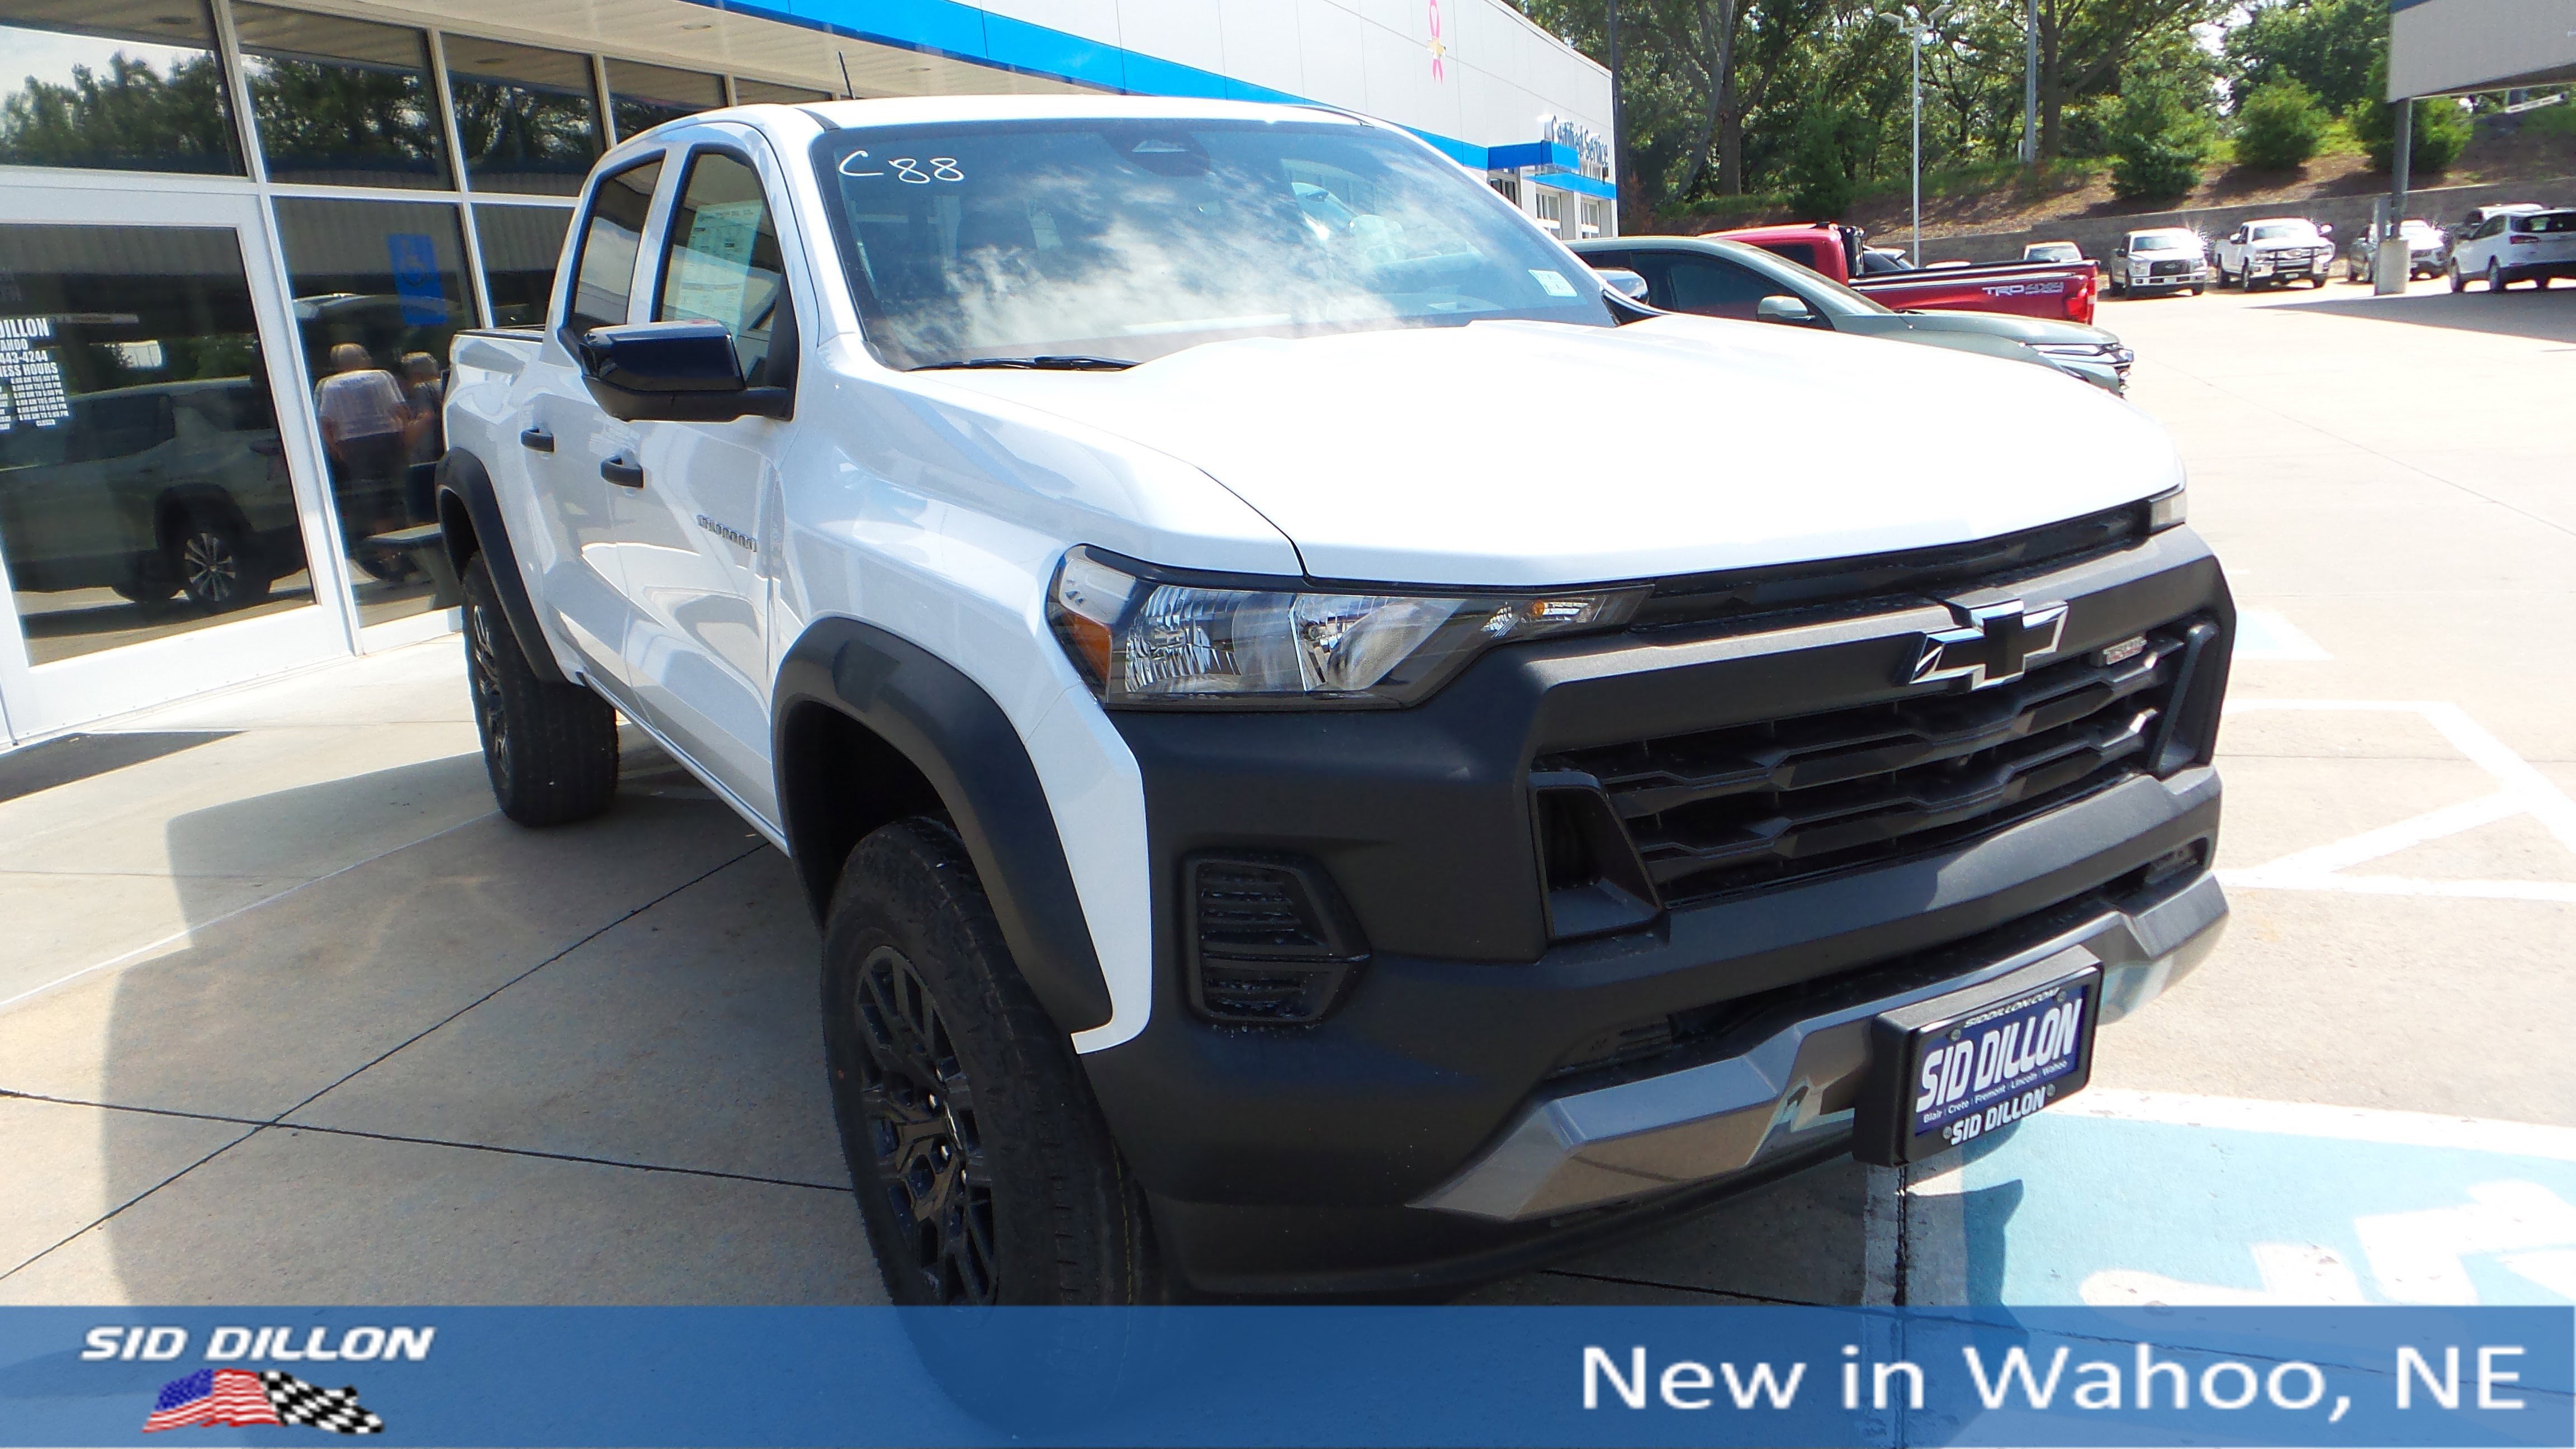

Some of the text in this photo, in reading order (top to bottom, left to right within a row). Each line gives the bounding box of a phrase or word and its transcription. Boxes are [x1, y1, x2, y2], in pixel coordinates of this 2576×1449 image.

[1982, 284, 2024, 297] TRD
[0, 338, 29, 351] AHOO
[22, 362, 58, 376] HOURS
[1916, 998, 2083, 1112] SID DILLON
[1923, 1110, 1943, 1123] Blair
[1948, 1100, 1969, 1114] Crete
[1974, 1085, 2006, 1104] Fremont
[1950, 1086, 2047, 1145] SID DILLON
